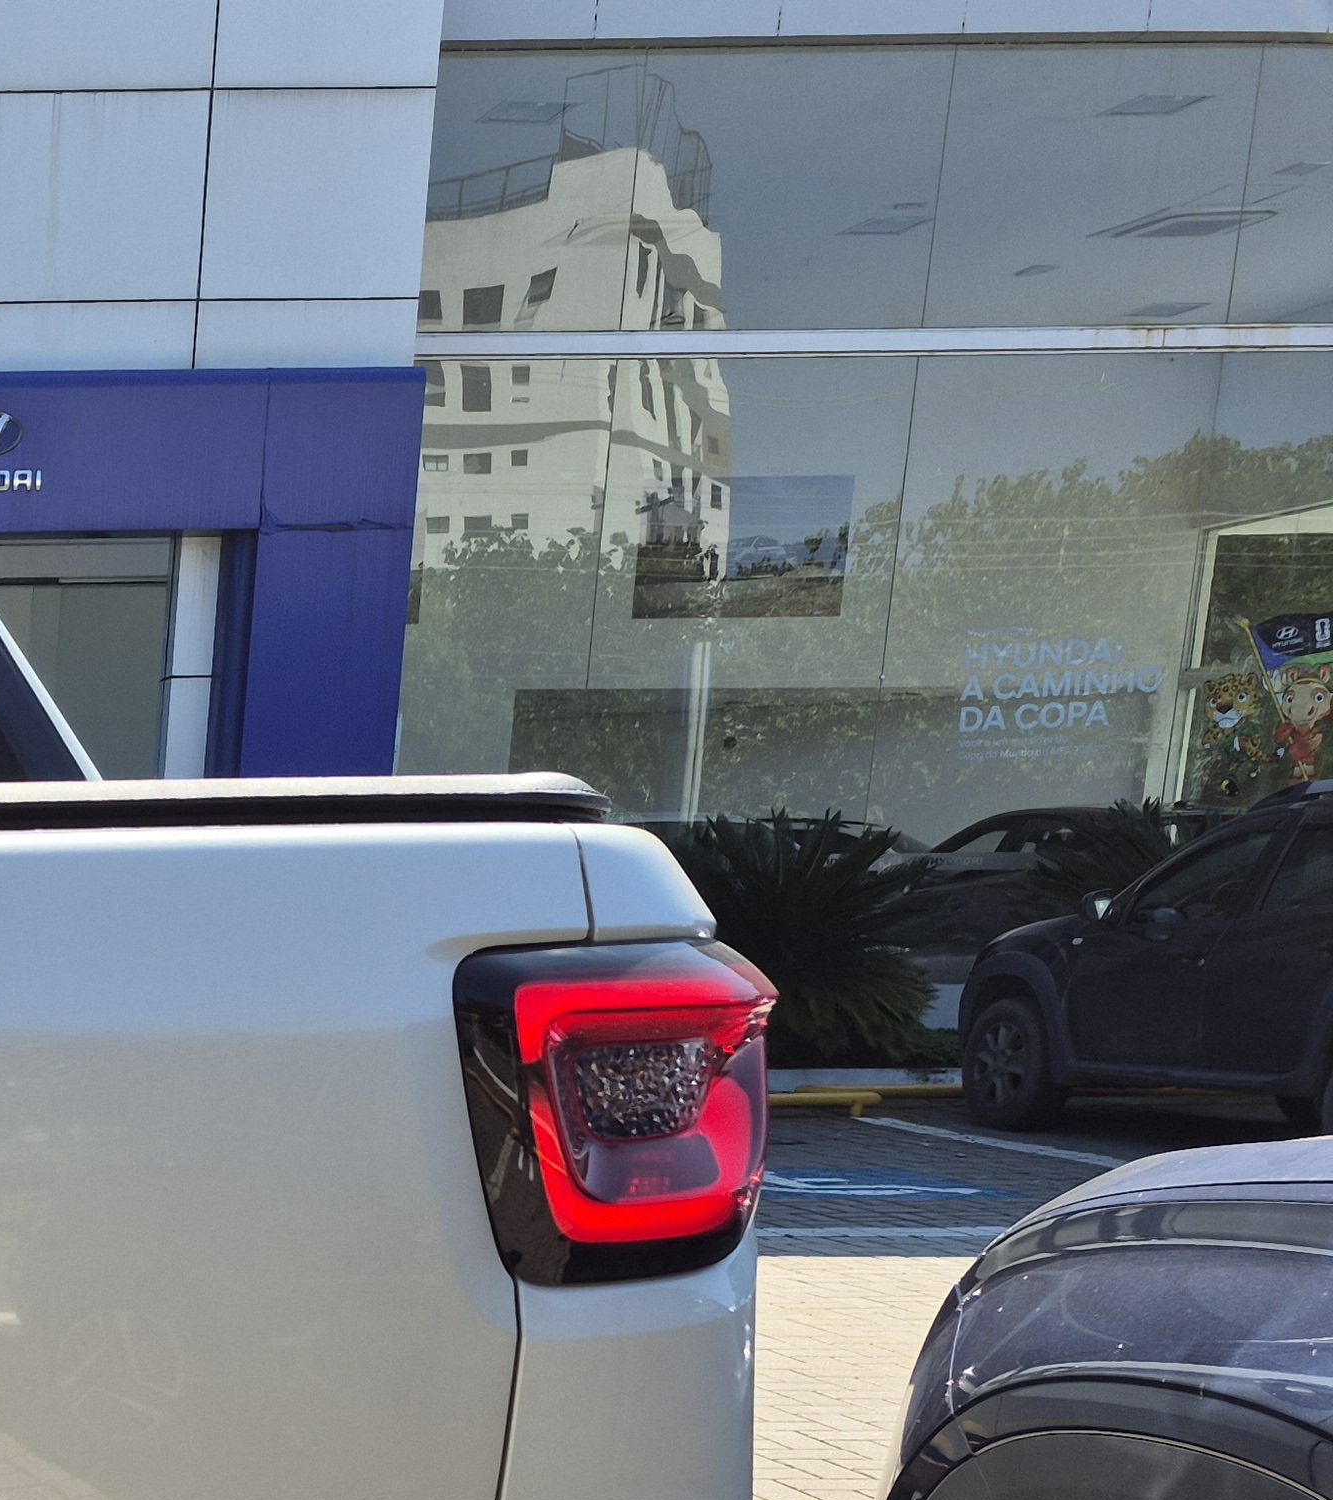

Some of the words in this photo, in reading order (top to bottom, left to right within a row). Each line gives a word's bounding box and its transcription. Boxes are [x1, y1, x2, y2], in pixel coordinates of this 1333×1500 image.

[964, 637, 1124, 670] HYUNDAI
[960, 675, 984, 701] A
[992, 665, 1164, 700] CAMINHO
[959, 704, 1007, 732] DA
[1014, 700, 1110, 731] COPA
